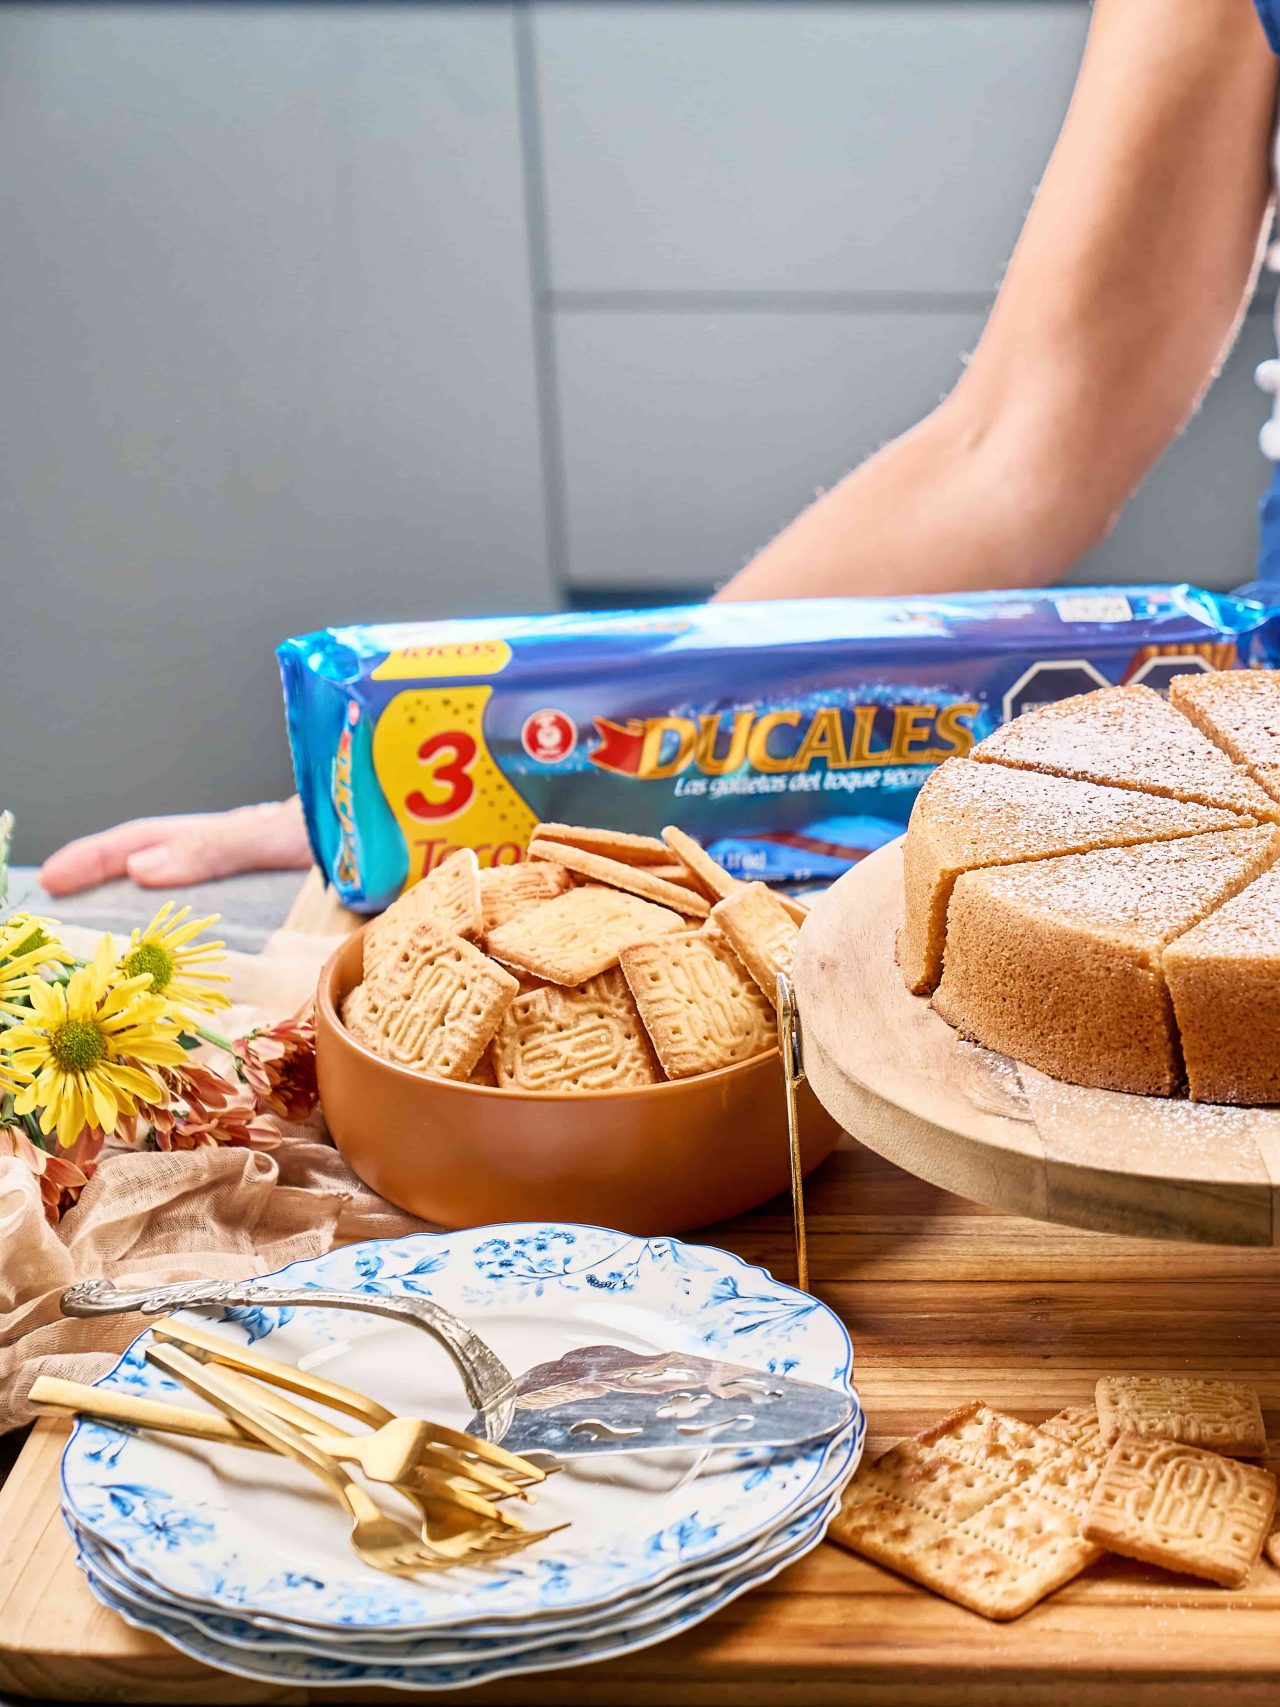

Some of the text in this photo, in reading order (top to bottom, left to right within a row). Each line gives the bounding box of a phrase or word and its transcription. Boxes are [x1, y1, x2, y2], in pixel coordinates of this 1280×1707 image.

[403, 730, 478, 820] 3
[636, 702, 982, 780] DUCALES
[674, 776, 707, 798] Las
[788, 769, 823, 792] del
